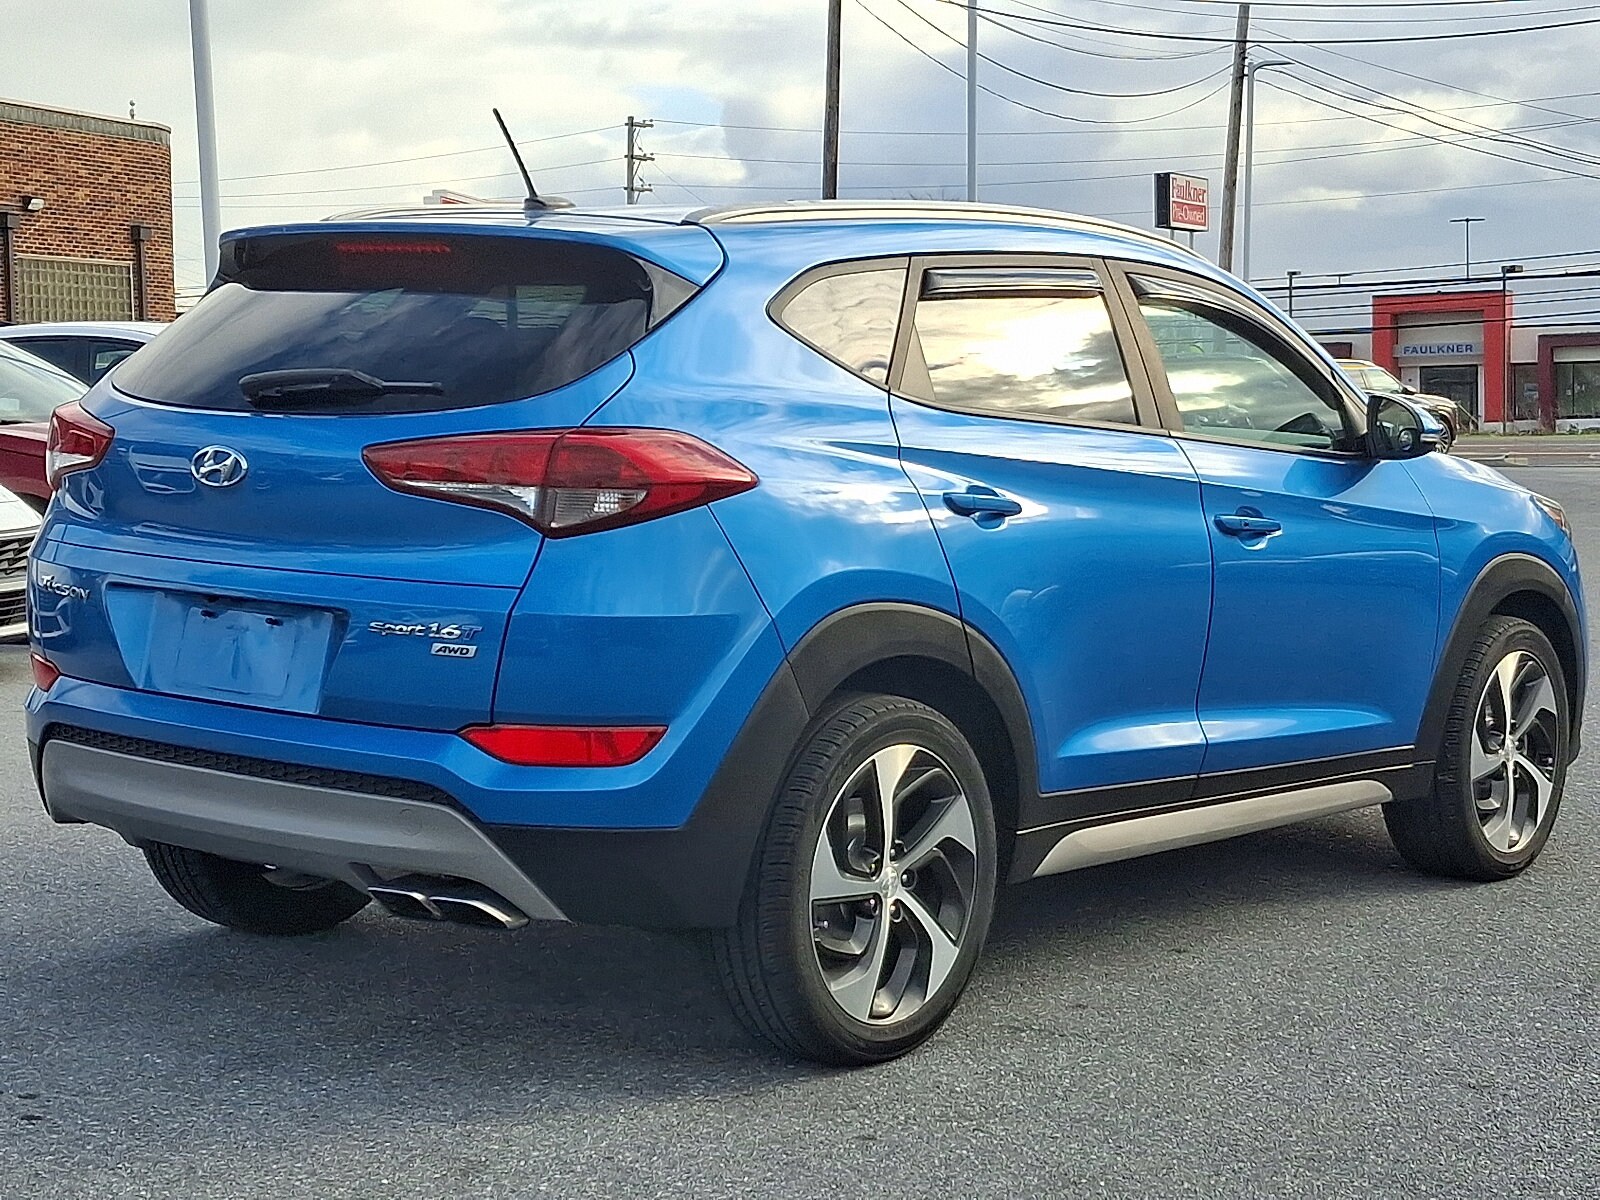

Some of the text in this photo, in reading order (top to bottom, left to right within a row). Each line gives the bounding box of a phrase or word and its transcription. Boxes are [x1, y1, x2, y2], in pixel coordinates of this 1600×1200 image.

[1171, 177, 1206, 203] Faulkner
[1172, 203, 1205, 223] Pre-Owned
[1403, 344, 1473, 355] FAULKNER
[435, 645, 470, 656] AWD
